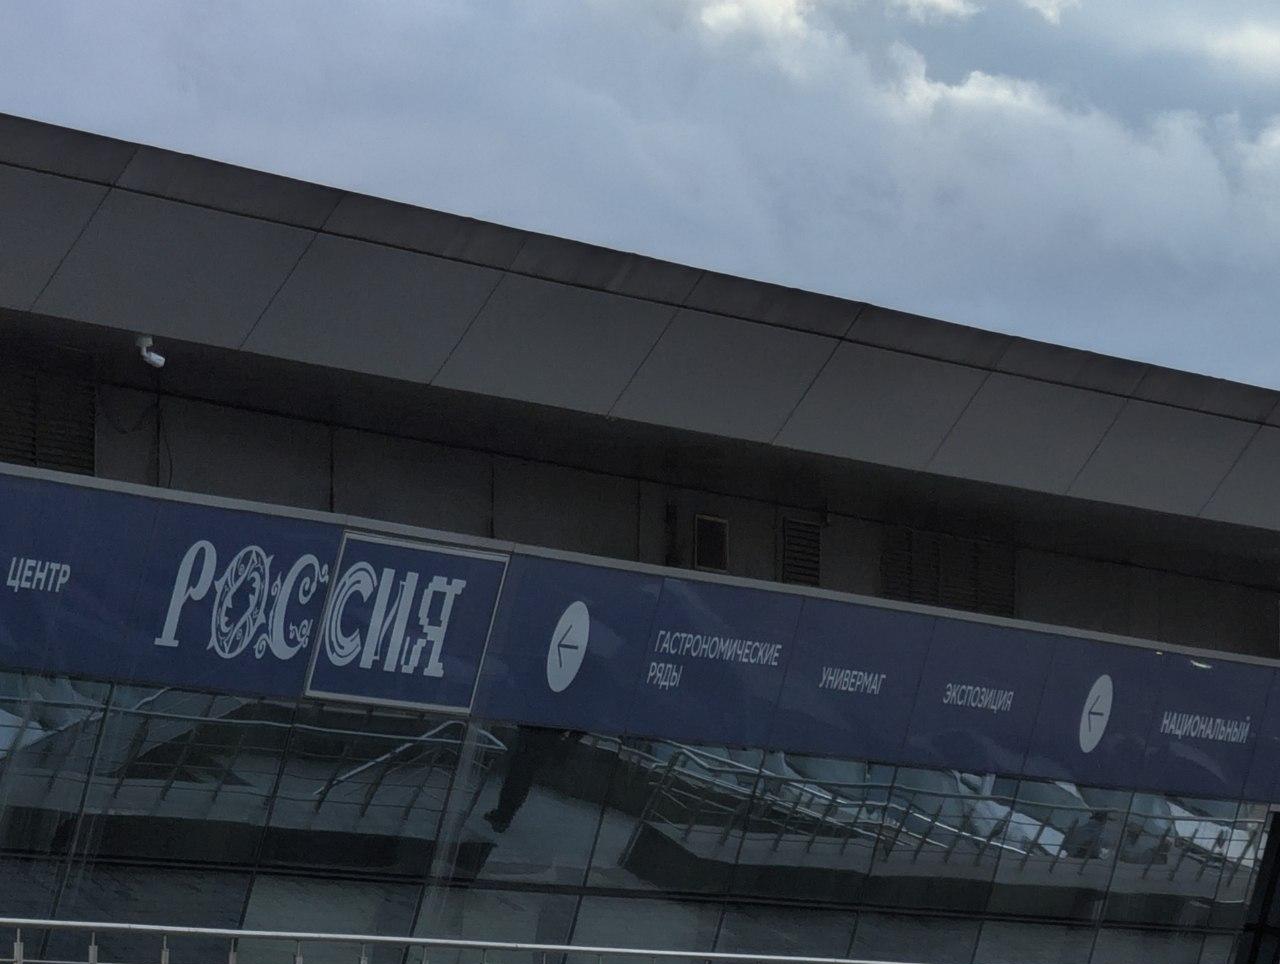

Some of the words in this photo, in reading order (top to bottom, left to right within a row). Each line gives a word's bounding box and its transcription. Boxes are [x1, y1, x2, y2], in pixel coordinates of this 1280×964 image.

[6, 557, 71, 593] ЦЕНТР
[154, 540, 466, 677] РОССИЯ
[655, 630, 783, 667] ГАСТРОНОМИЧЕСКИЕ
[646, 661, 683, 690] РЯДЫ
[818, 666, 887, 695] УНИВЕРМАГ
[943, 684, 1013, 713] ЭКСПОЗИЦИЯ
[1160, 711, 1251, 744] НАЦИОНАЛЬНЫЙ
